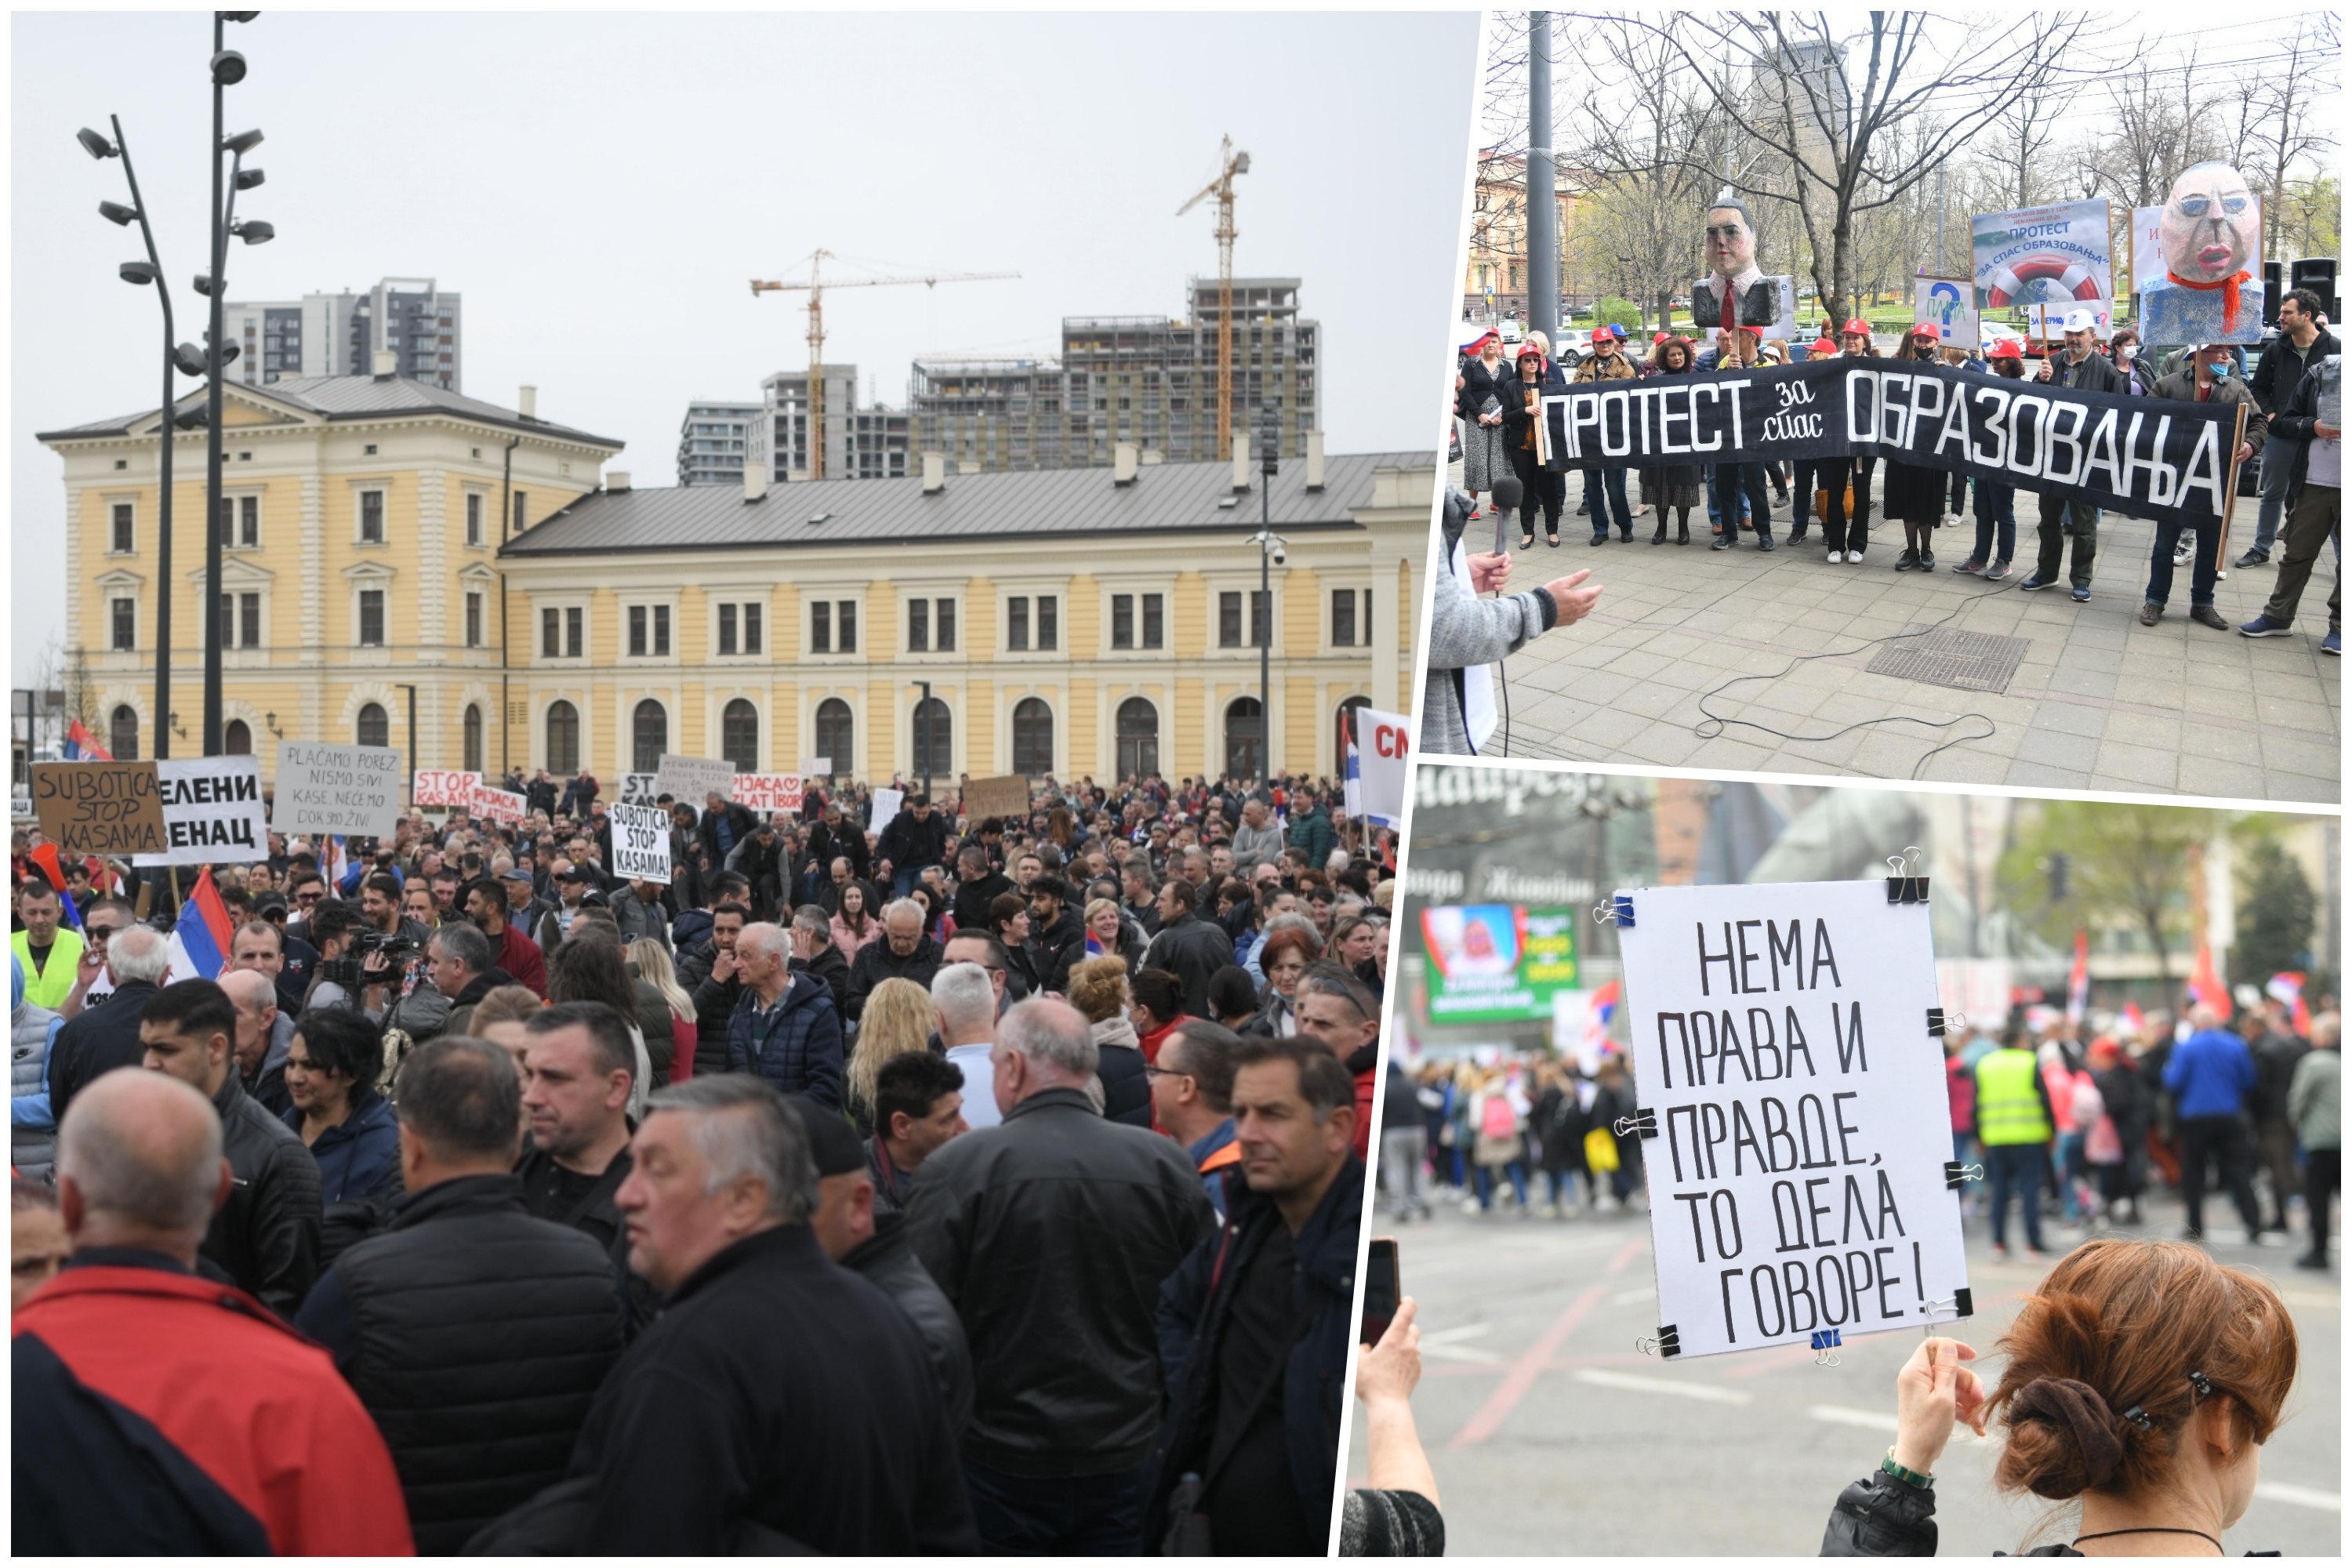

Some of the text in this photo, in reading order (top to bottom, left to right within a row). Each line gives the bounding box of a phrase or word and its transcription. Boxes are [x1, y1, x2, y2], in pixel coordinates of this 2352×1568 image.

[2009, 221, 2071, 241] ПРОТЕСТ
[1993, 245, 2020, 264] СПАС
[1541, 379, 1751, 460] ПРОТЕСТ
[1776, 379, 1816, 408] за
[1846, 369, 2224, 517] ОБРАЗОВАЊА
[358, 753, 397, 771] POREZ
[39, 768, 159, 800] SUBOTICA
[159, 775, 257, 807] ЕЛЕНИ
[310, 770, 353, 786] NISMO
[417, 771, 475, 792] STOP
[625, 775, 654, 794] ST
[72, 798, 140, 822] STOP
[416, 792, 470, 804] KASAM
[297, 809, 324, 826] DOK
[614, 804, 667, 831] SUBOTICA
[61, 822, 159, 850] KASAMA
[164, 818, 256, 848] ЕНАЦ
[627, 827, 656, 850] STOP
[616, 848, 670, 877] KASAMA!
[1697, 918, 1841, 996] НЕМА
[1657, 1001, 1867, 1089] ПРАВА И
[1667, 1091, 1882, 1182] ПРАВДЕ,
[1674, 1169, 1906, 1263] ТО ДЕЛА
[1721, 1242, 1926, 1343] ГОВОРЕ!
